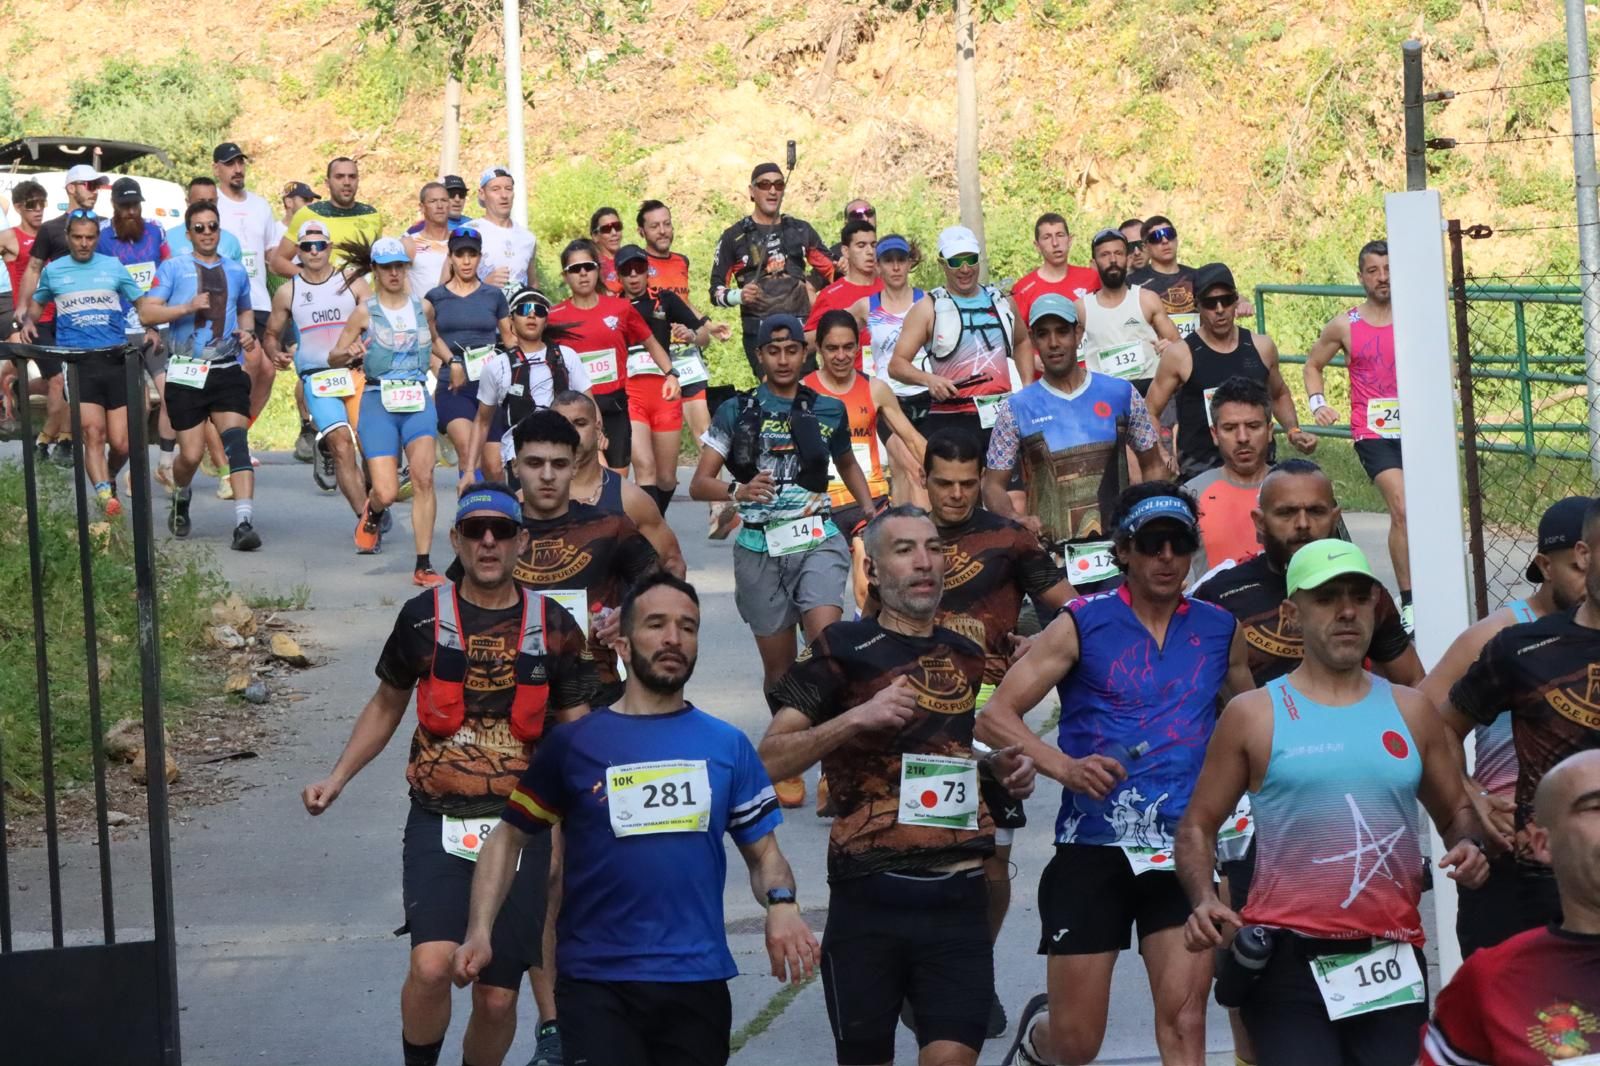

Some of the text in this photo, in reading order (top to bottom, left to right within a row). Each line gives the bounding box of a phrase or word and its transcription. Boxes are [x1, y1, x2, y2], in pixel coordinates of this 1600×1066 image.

[134, 270, 152, 283] 257
[312, 308, 341, 324] CHICO
[1114, 352, 1137, 366] 132
[184, 366, 198, 376] 19
[589, 360, 610, 374] 105
[326, 376, 347, 388] 380
[792, 524, 809, 538] 14
[532, 573, 550, 582] LOS
[552, 554, 589, 580] FUERTES
[1247, 631, 1298, 656] C.D.E. LOS
[928, 700, 948, 711] LOS
[1552, 696, 1582, 720] C.D.E.
[906, 766, 926, 776] 21K
[613, 776, 634, 787] 10K
[642, 781, 696, 808] 281
[943, 780, 965, 804] 73
[1354, 957, 1402, 989] 160
